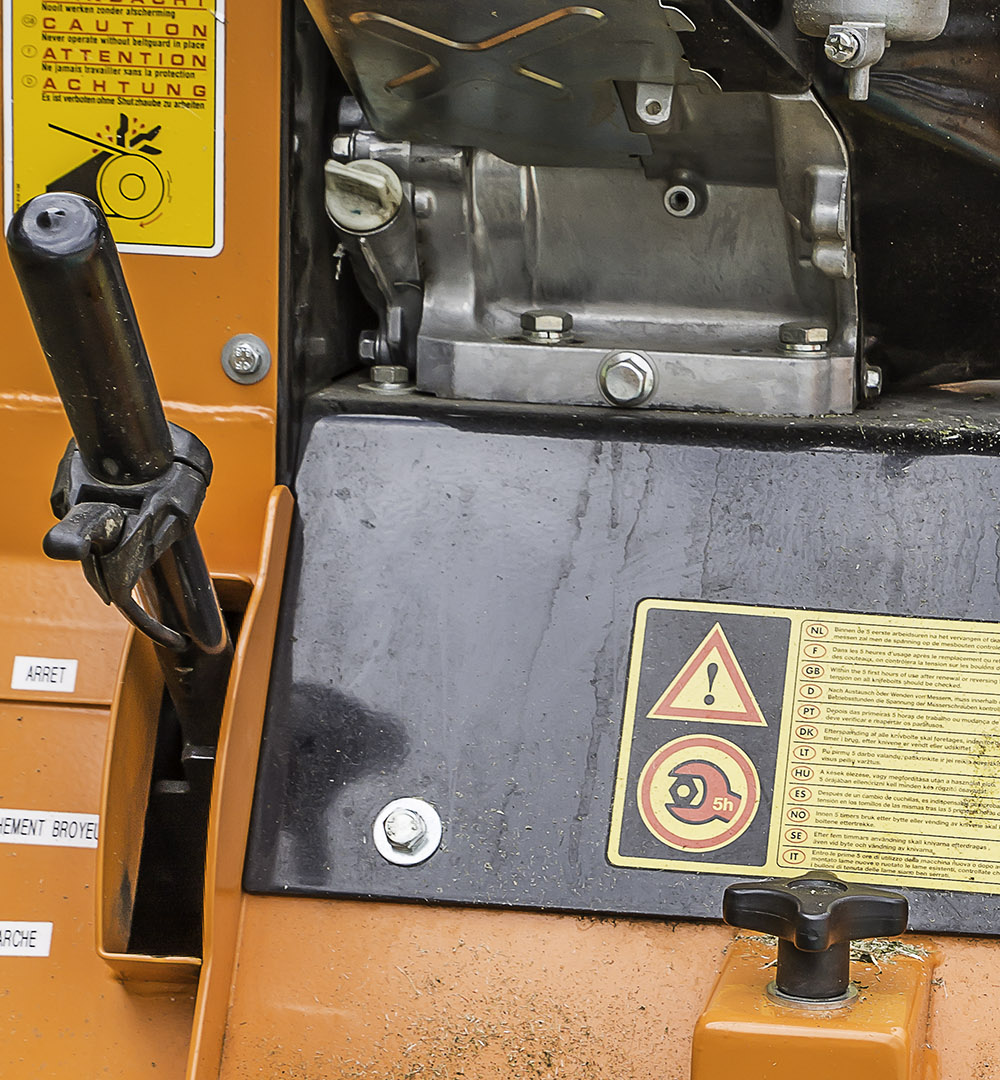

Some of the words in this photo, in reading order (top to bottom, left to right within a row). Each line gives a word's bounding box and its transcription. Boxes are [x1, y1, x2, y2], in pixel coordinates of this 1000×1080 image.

[43, 17, 207, 37] CAUTION
[43, 47, 206, 67] ATTENTION
[43, 78, 206, 97] ACHTUNG
[26, 664, 66, 684] ARRET
[806, 667, 820, 675] GB
[803, 707, 815, 716] PT
[799, 728, 814, 736] DK
[795, 769, 810, 777] HU
[795, 790, 806, 798] ES
[712, 798, 734, 812] 5h
[790, 810, 806, 819] NO
[790, 831, 802, 840] SE
